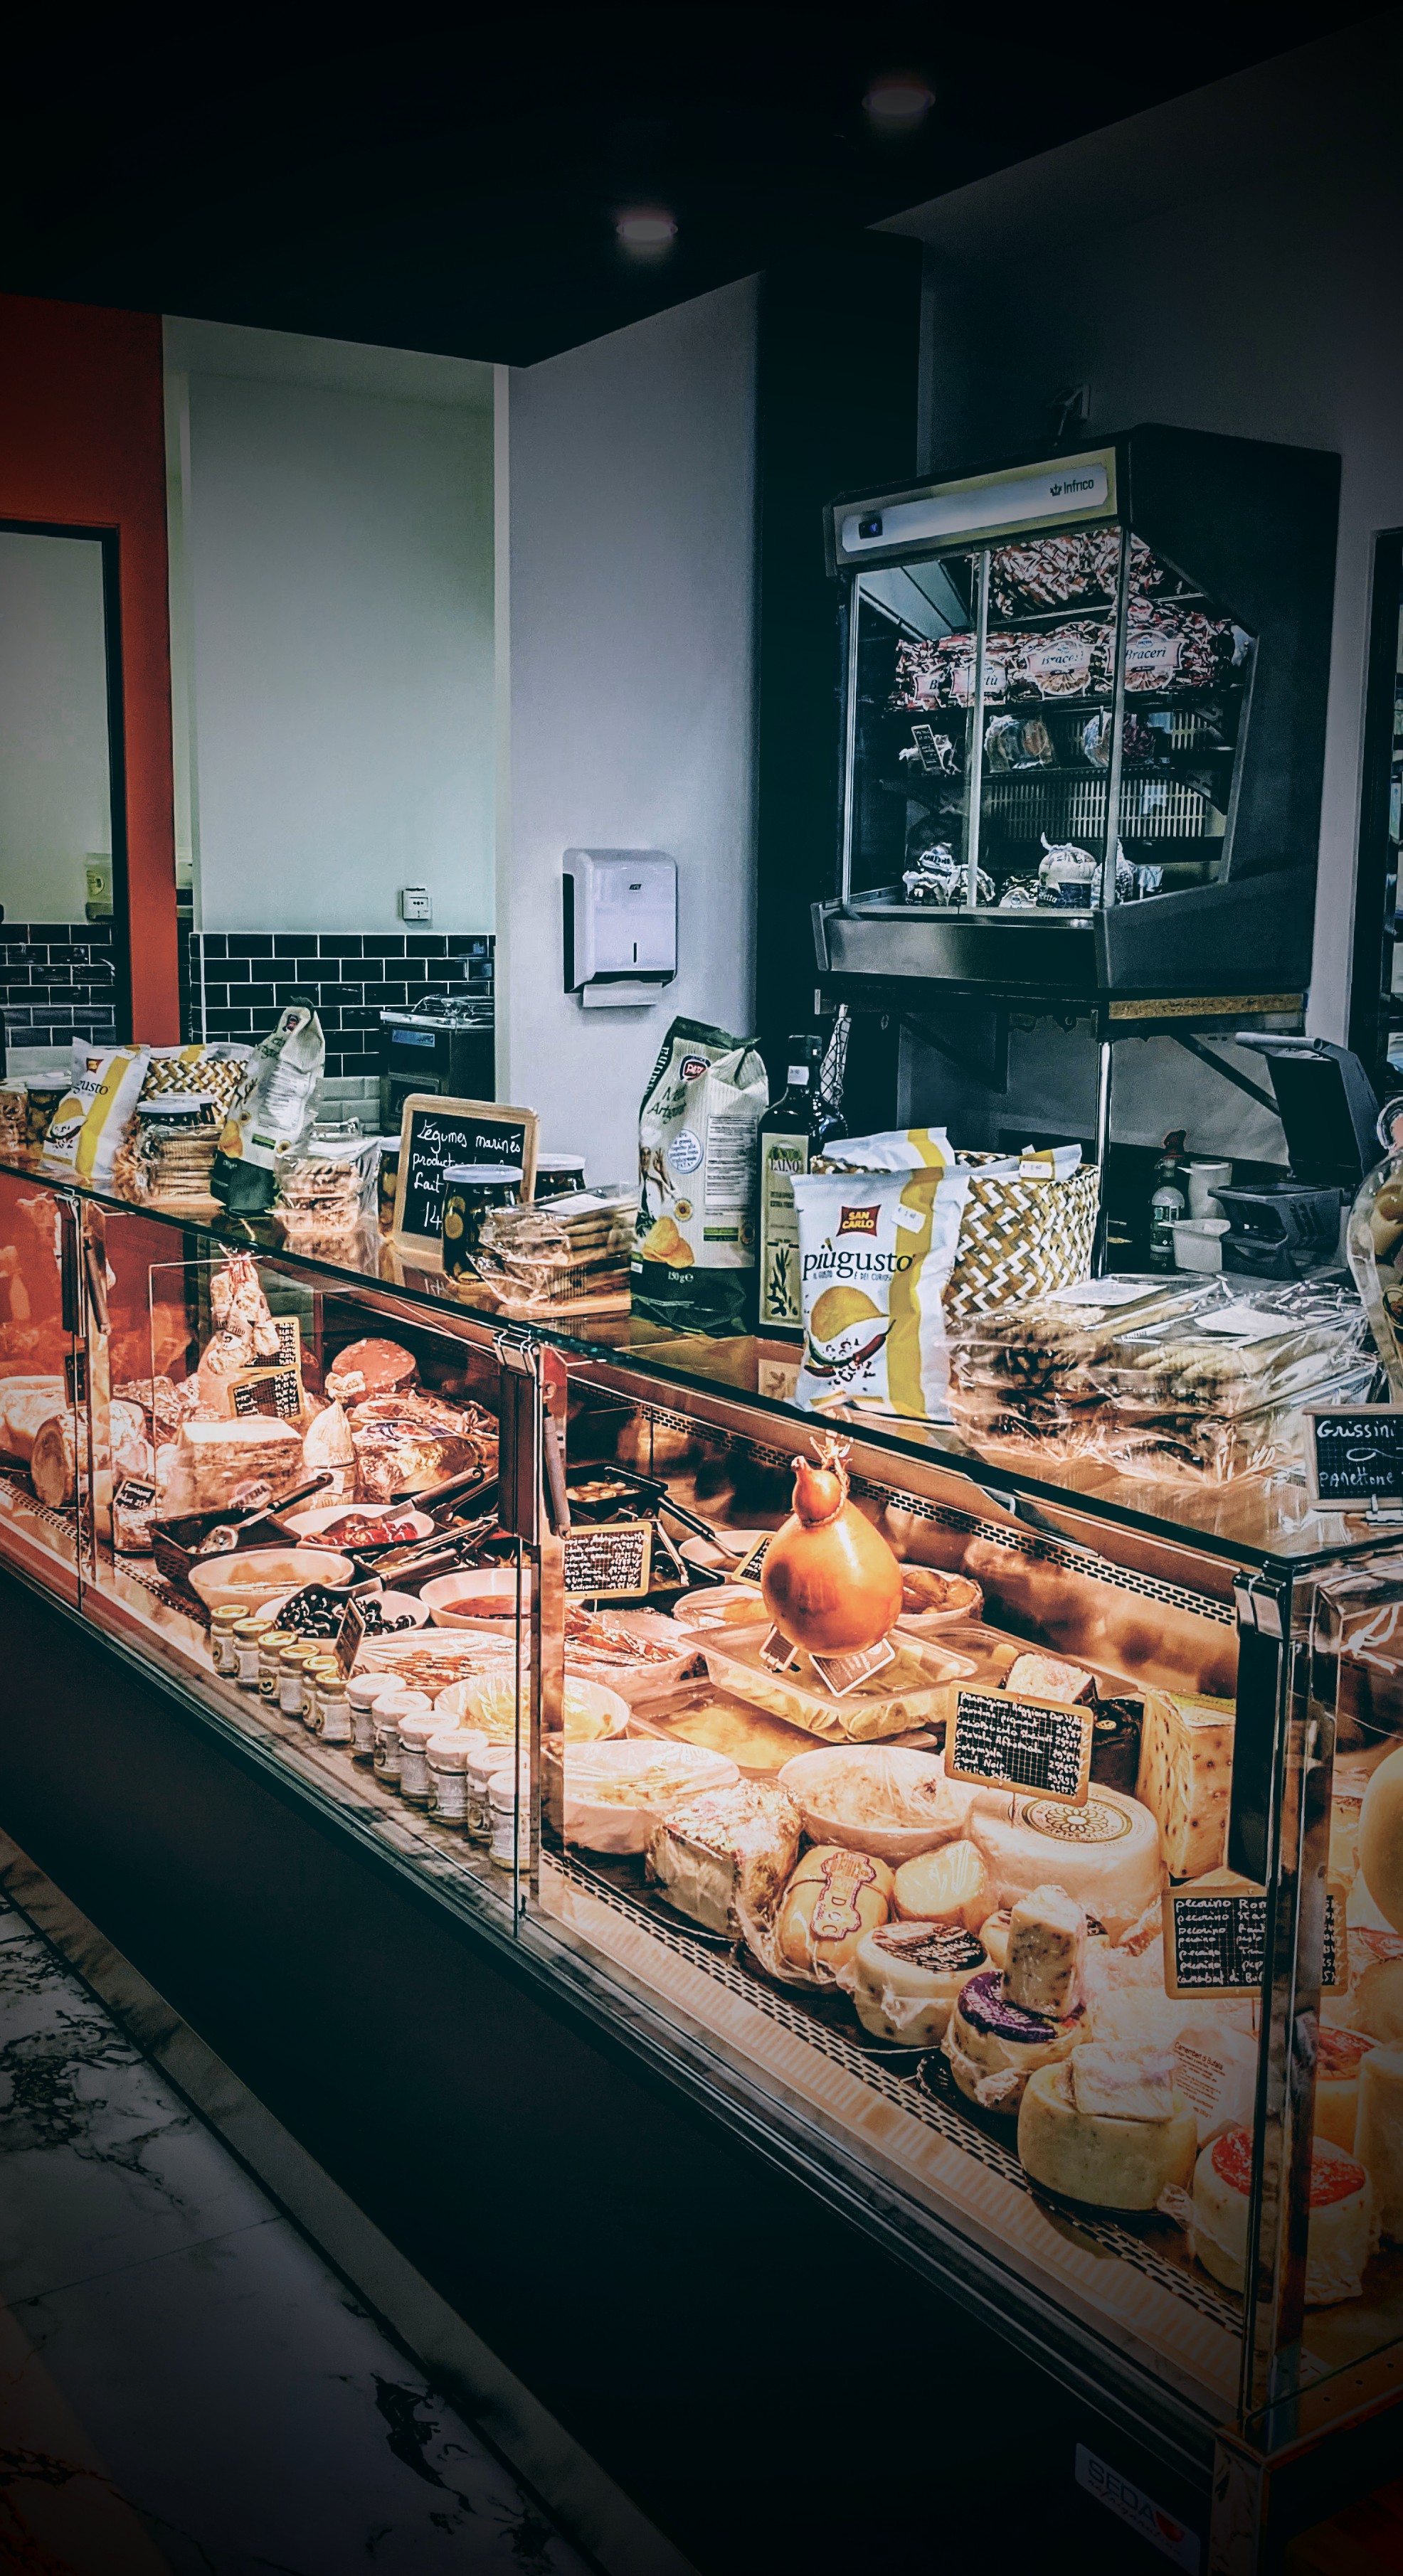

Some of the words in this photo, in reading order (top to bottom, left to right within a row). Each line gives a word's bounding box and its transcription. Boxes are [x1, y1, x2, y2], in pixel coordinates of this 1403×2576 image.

[1064, 479, 1094, 494] Infrico
[848, 1211, 870, 1220] SAN
[842, 1219, 875, 1229] CARLO
[803, 1238, 916, 1281] piùgusto
[1317, 1420, 1396, 1437] Grissini
[1089, 2459, 1157, 2527] SEDA
